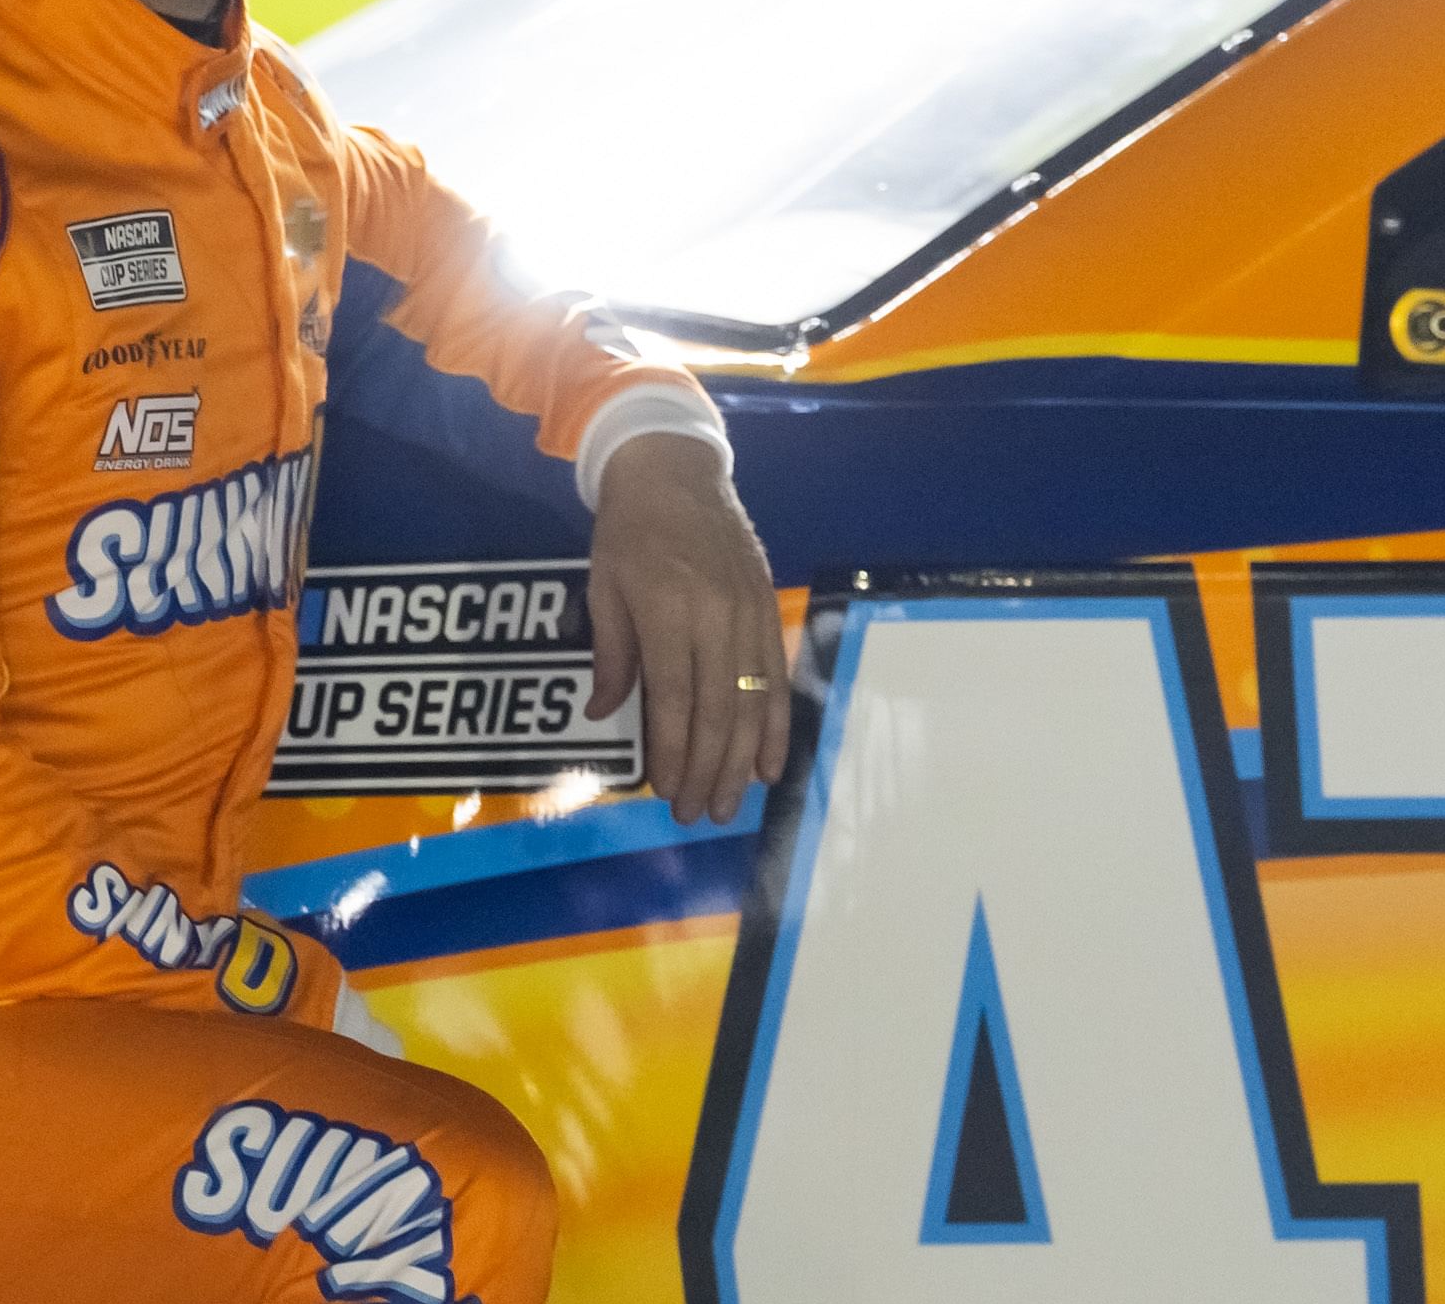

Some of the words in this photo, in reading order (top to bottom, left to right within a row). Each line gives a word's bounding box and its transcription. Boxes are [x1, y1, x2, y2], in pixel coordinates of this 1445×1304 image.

[104, 220, 160, 251] NASCAR
[100, 263, 125, 288] CUP
[127, 257, 167, 283] SERIES
[98, 394, 200, 454] NOS
[93, 459, 150, 471] ENERGY
[153, 456, 191, 469] DRINK
[322, 580, 567, 645] NASCAR
[374, 676, 577, 736] SERIES
